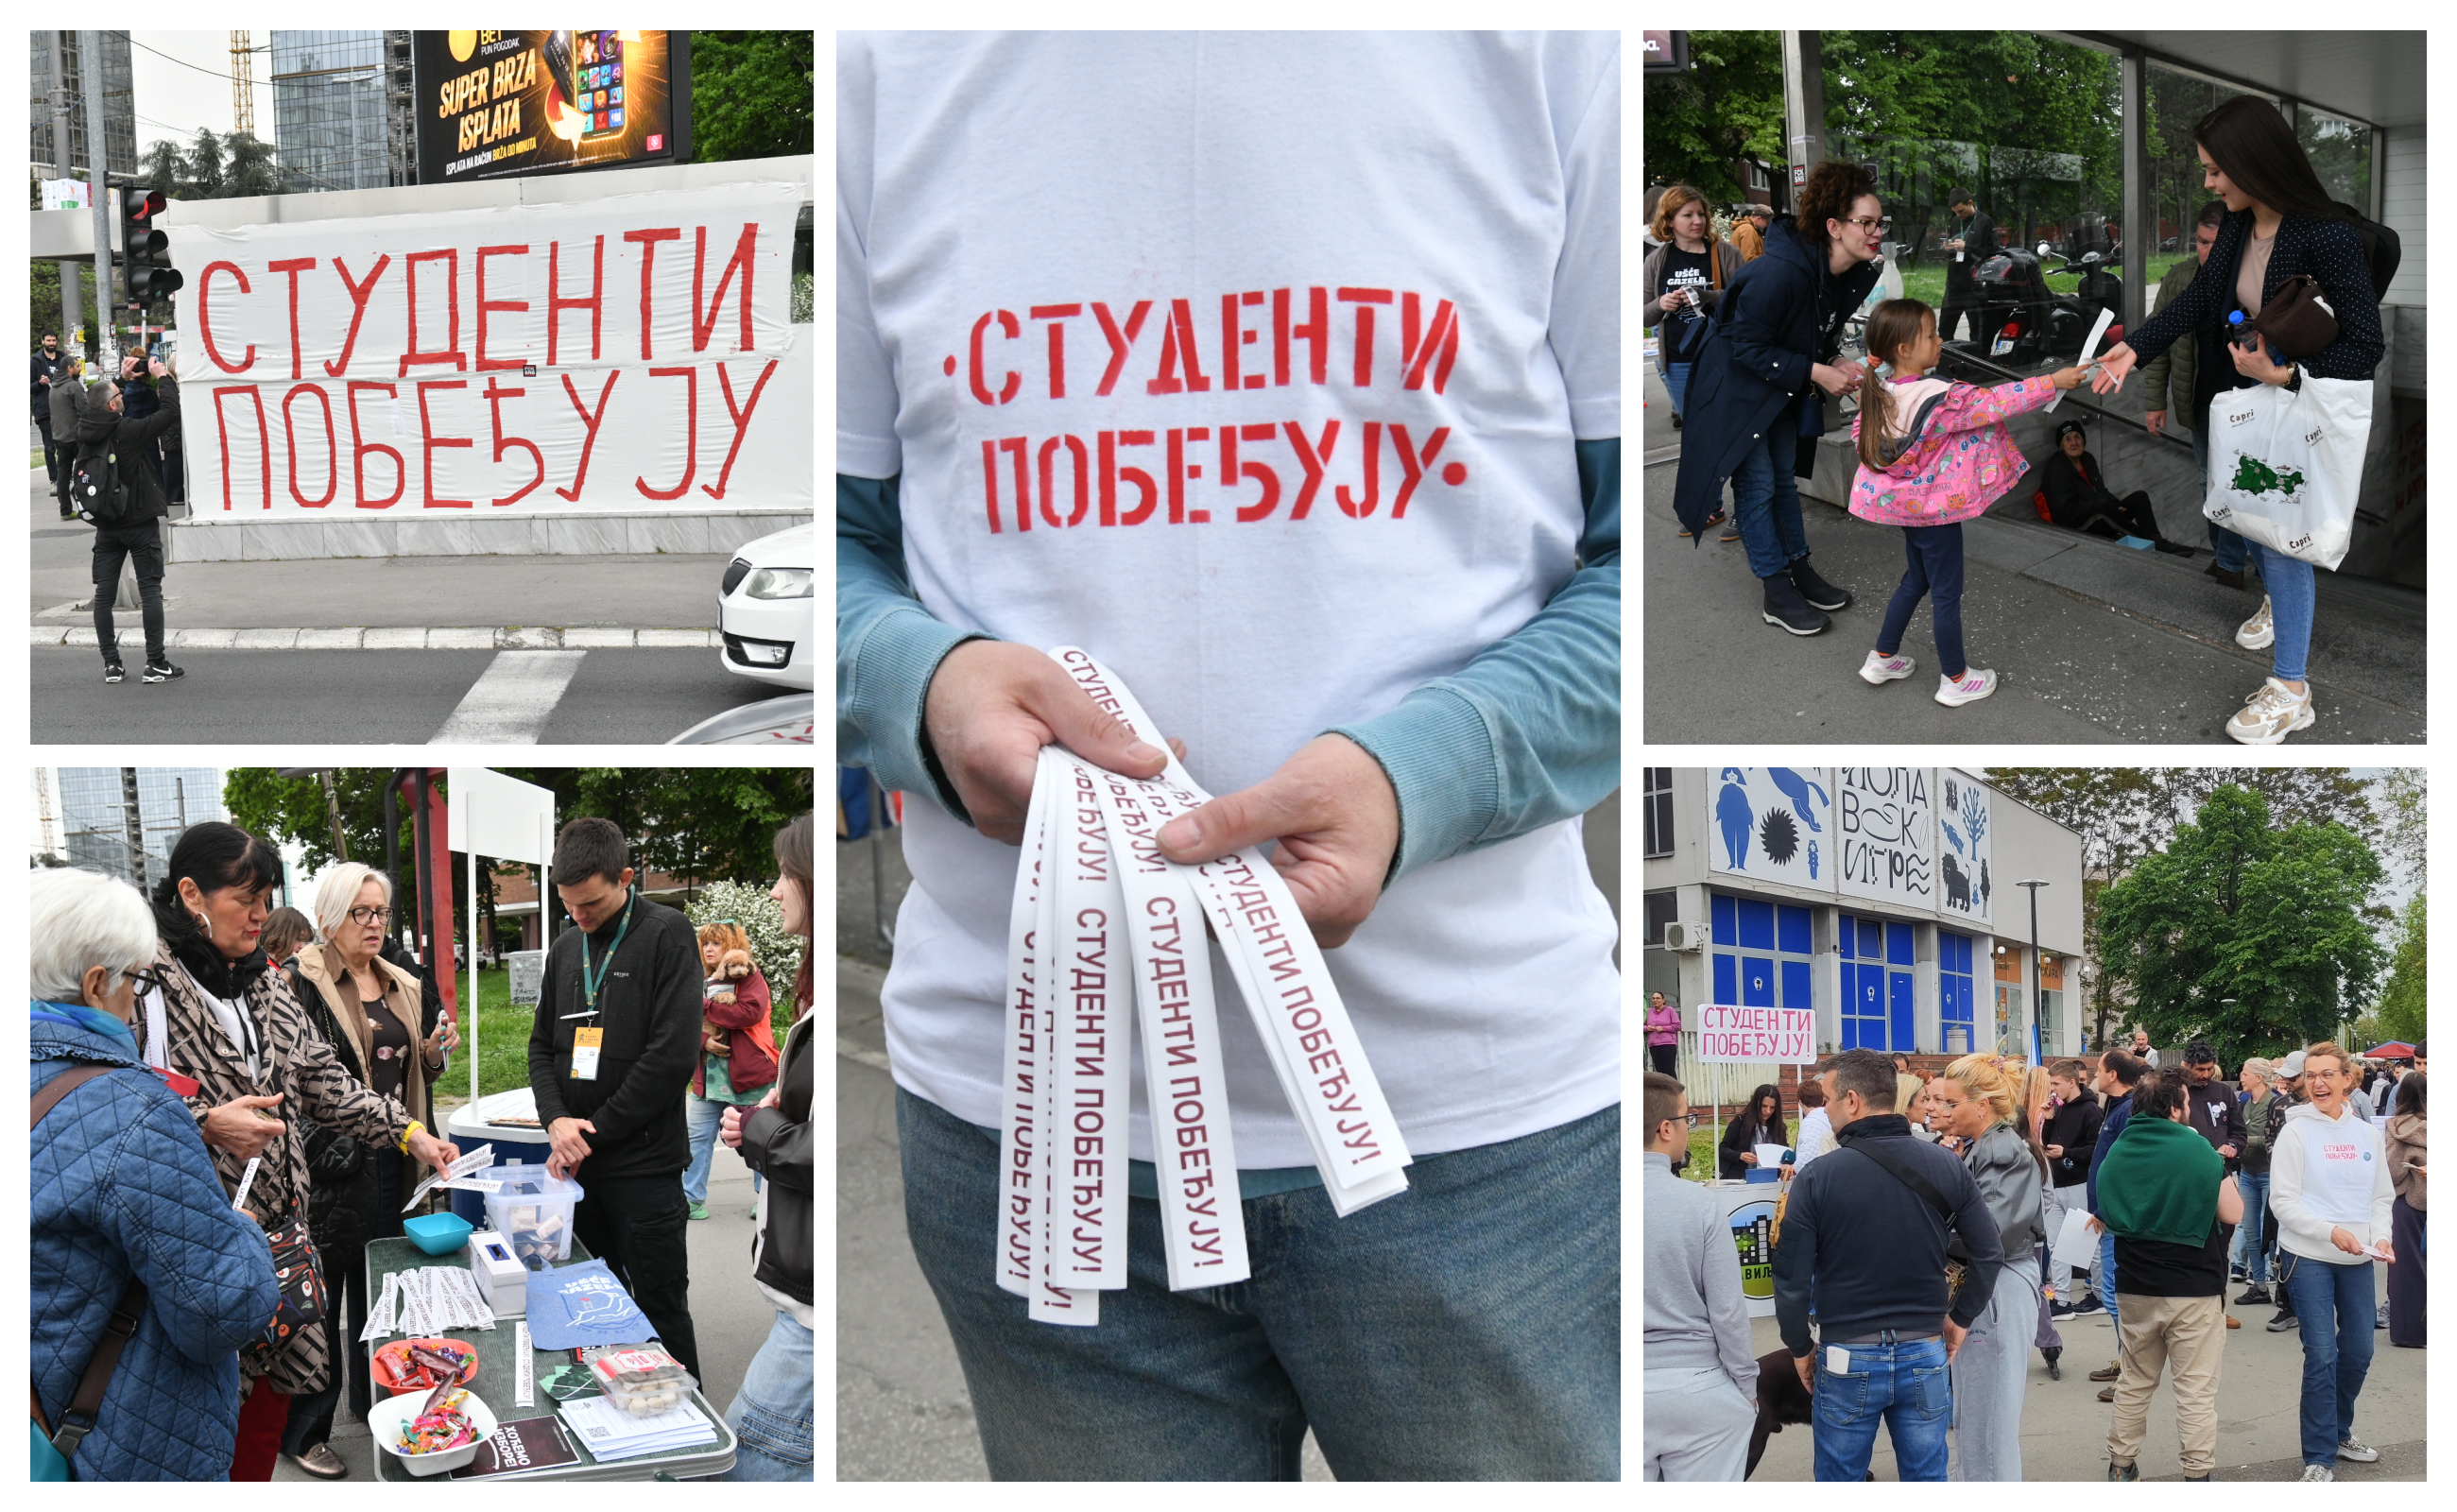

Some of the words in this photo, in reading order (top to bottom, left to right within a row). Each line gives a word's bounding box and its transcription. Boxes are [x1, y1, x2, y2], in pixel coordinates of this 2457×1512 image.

[481, 43, 492, 56] PUN
[493, 37, 520, 53] POGODAK
[438, 66, 490, 119] SUPER
[492, 48, 536, 100] BRZA
[457, 97, 520, 153] ISPLATA
[446, 161, 466, 176] ISPLATA
[465, 159, 473, 171] NA
[473, 150, 491, 168] RAČUN
[515, 137, 537, 155] MINUTA
[1675, 266, 1700, 278] UŠĆE
[198, 222, 759, 379] СТУДЕНТИ
[2229, 409, 2254, 422] Capri
[2305, 425, 2323, 443] Capri
[2212, 506, 2230, 518] Capri
[2289, 533, 2311, 549] Capri
[1069, 908, 1107, 1077] СТУДЕНТИ
[1146, 896, 1197, 1067] СТУДЕНТИ
[1214, 853, 1302, 983] СТУДЕНТИ
[1280, 985, 1383, 1166] ПОБЕЂУЈУ!
[1704, 1006, 1811, 1032] СТУДЕНТИ
[1703, 1033, 1811, 1057] ПОБЕЂУЈУ!
[1072, 1089, 1105, 1273] ПОБЕЂУЈУ!
[1170, 1078, 1225, 1269] ПОБЕЂУЈУ!
[1741, 1266, 1773, 1280] ВИЉ
[493, 1428, 519, 1468] ИЗБОРЕ!
[504, 1425, 531, 1466] ХОЋЕМО
